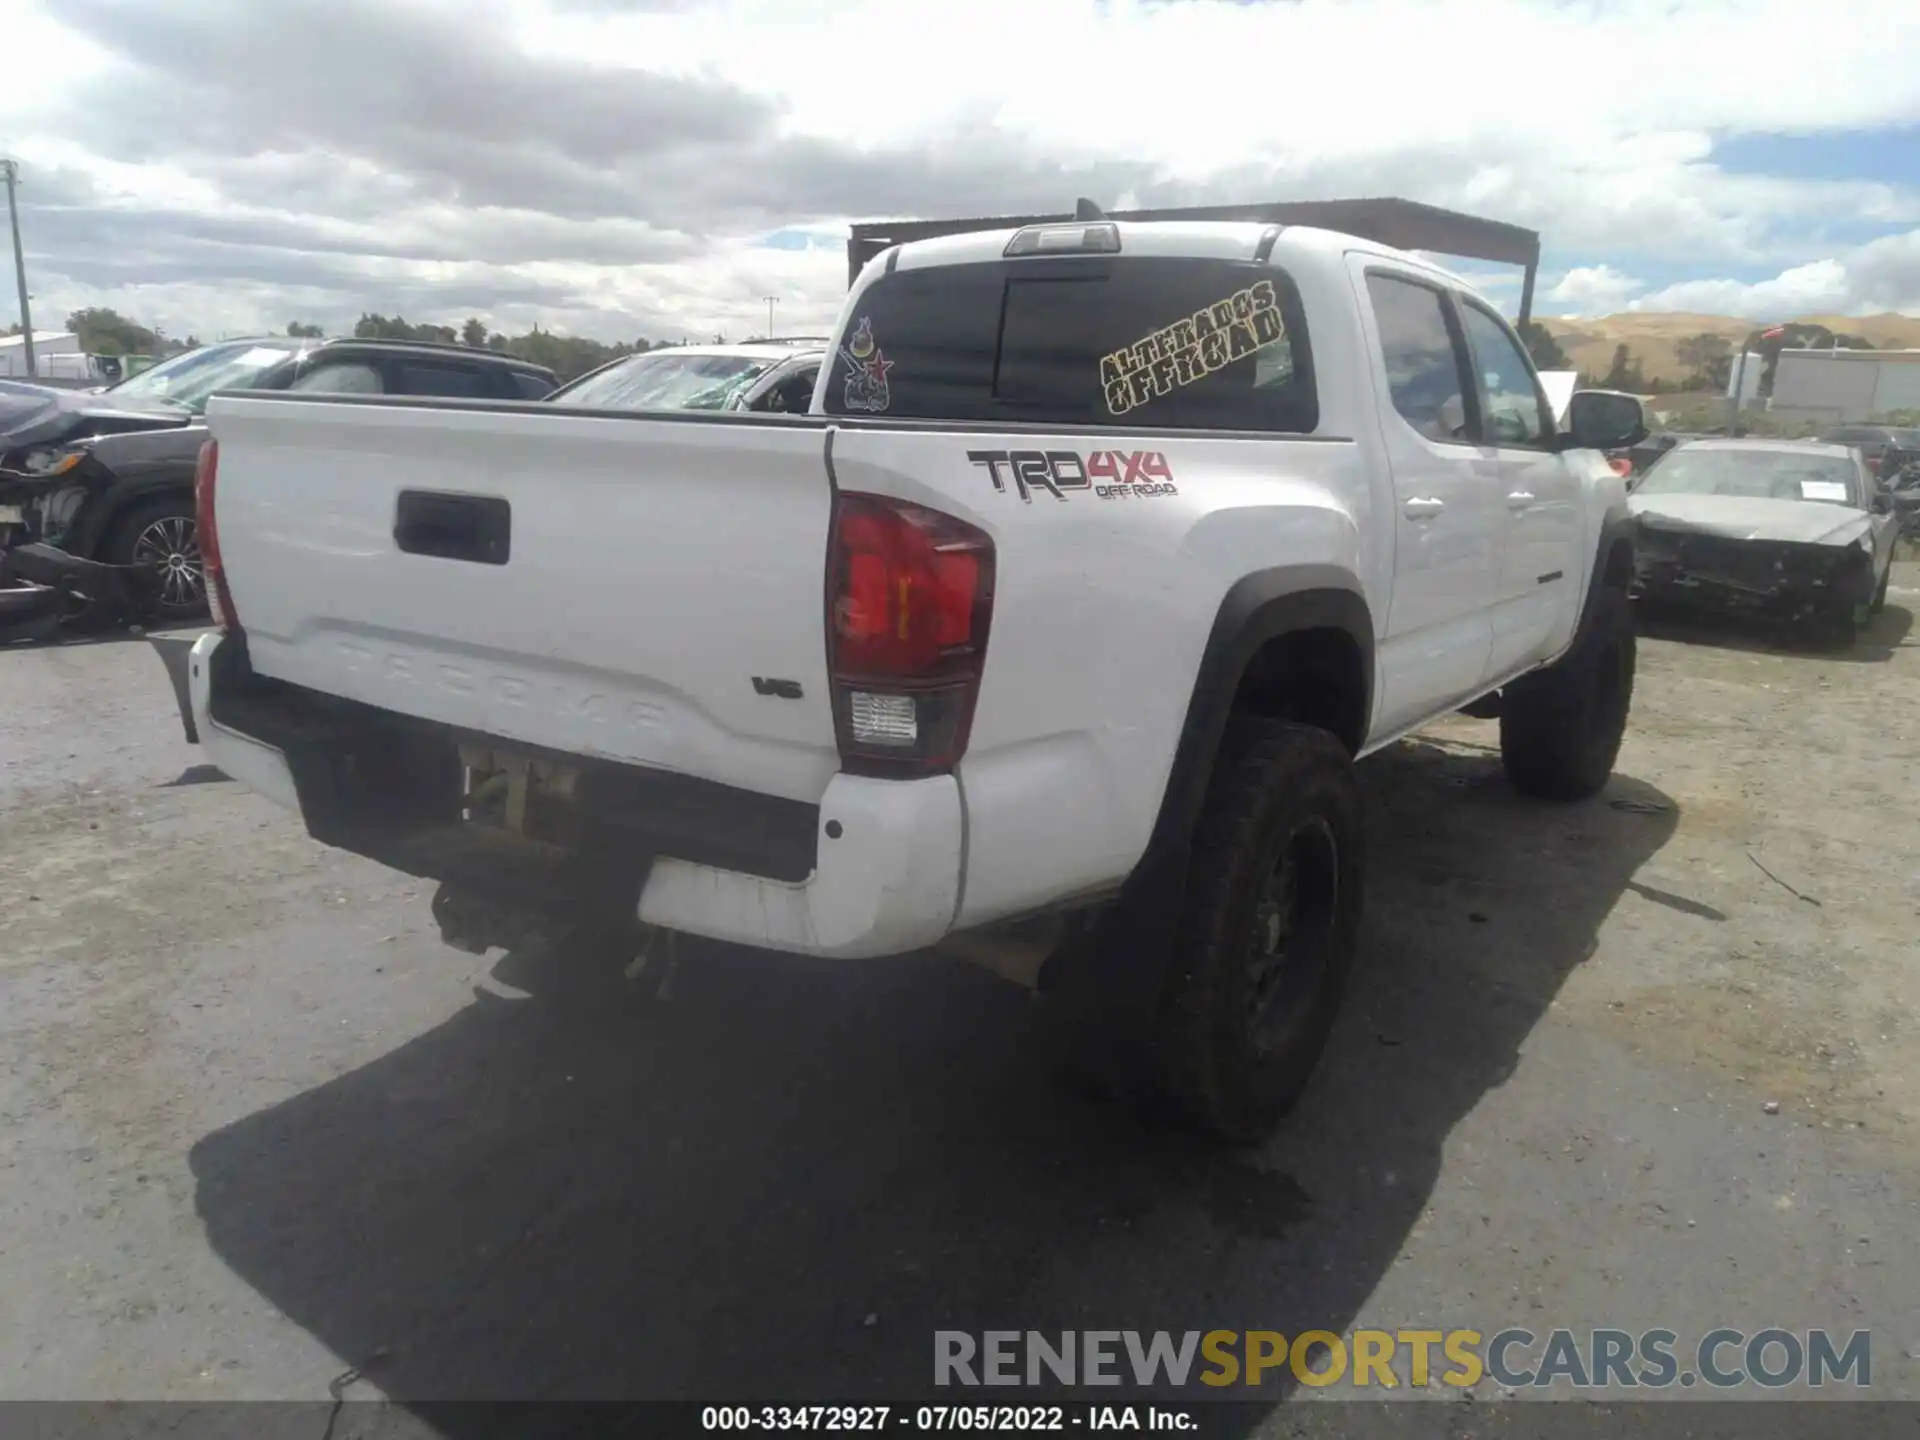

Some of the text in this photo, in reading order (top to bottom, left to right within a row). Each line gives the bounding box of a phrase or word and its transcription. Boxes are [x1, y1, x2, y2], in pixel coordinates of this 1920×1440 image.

[1100, 280, 1276, 386] ALTERADOS
[1104, 305, 1285, 415] OFFROAD
[966, 450, 1174, 503] TRD 4X4
[751, 676, 804, 699] V6
